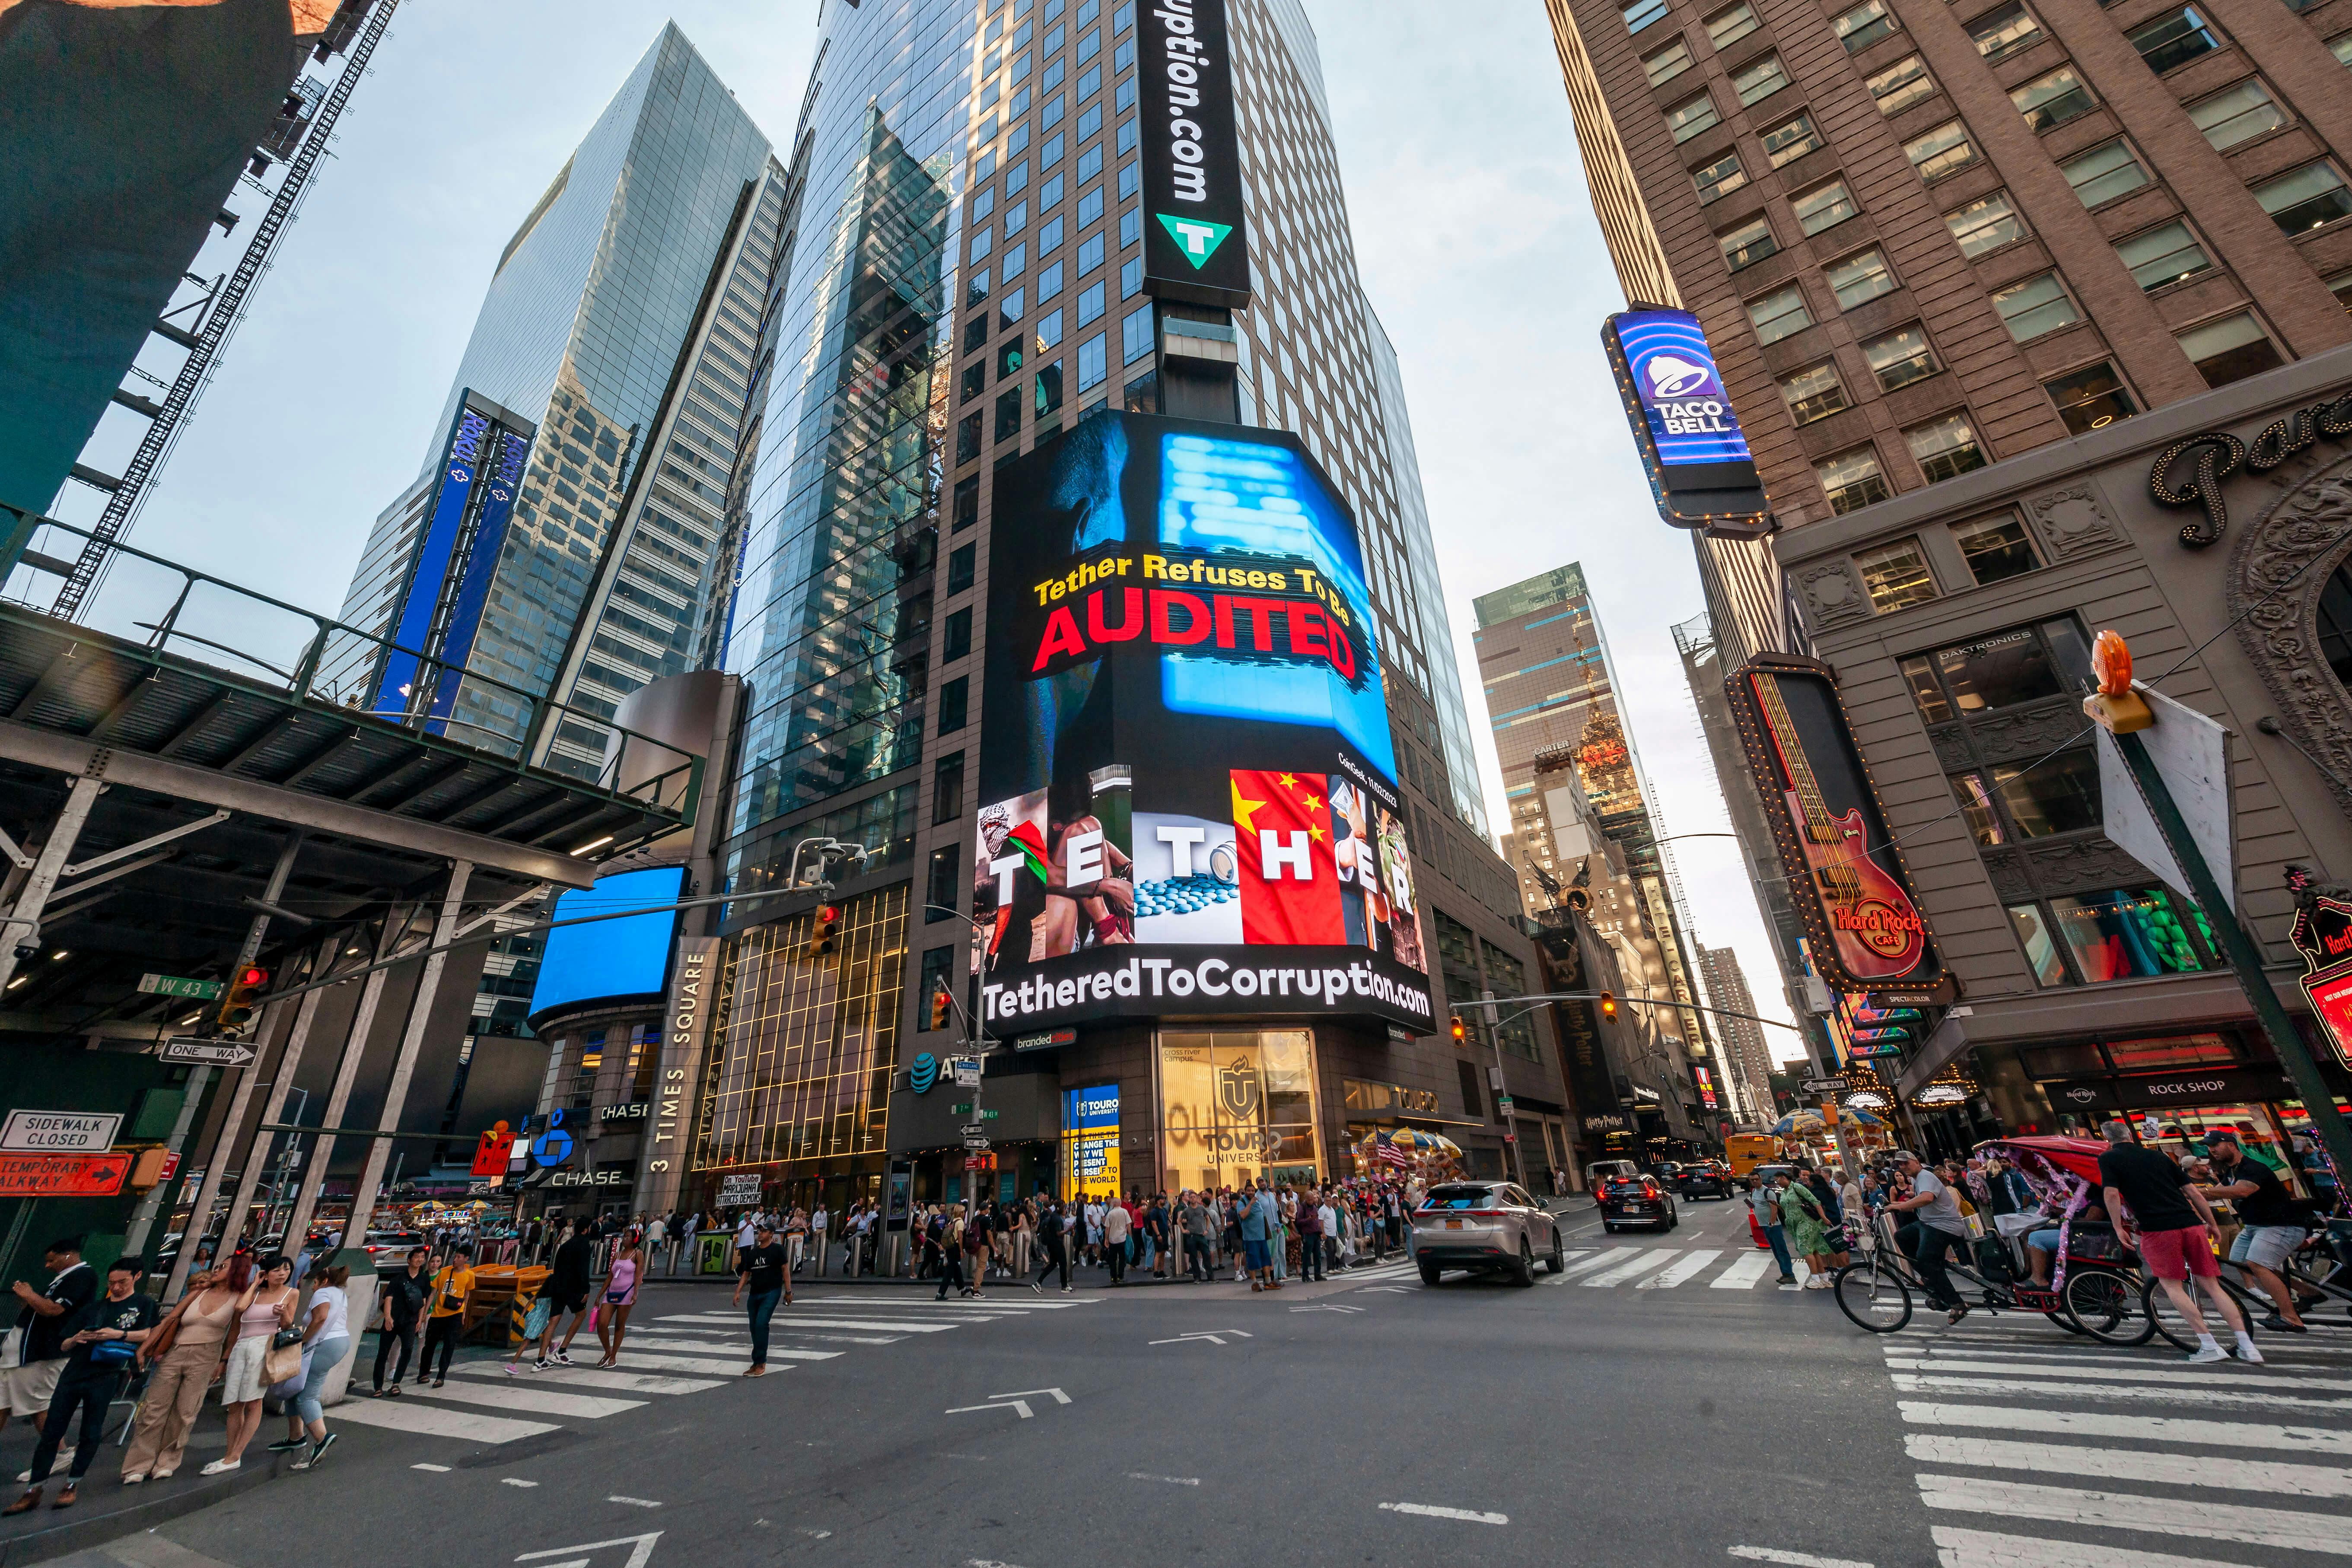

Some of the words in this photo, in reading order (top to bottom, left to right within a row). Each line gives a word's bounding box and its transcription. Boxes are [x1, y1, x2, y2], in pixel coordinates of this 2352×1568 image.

[1654, 401, 1723, 419] TACO
[1665, 417, 1730, 434] BELL
[1034, 557, 1132, 606] Tether
[1143, 554, 1286, 590] Refuses
[1295, 569, 1325, 600] To
[1329, 588, 1349, 627] Be
[1032, 587, 1355, 679] AUDITED
[1939, 631, 2031, 660] DAKTRONICS
[1534, 740, 1569, 755] CARTER
[1339, 753, 1367, 785] CoinGeek,
[1368, 777, 1397, 808] 11/02/2023
[1647, 885, 1674, 952] HOTEL
[1836, 908, 1879, 929] Hard
[1881, 909, 1925, 935] Rock
[1875, 935, 1901, 946] CAFE
[2325, 928, 2350, 955] Hard
[161, 979, 177, 993] W
[182, 982, 201, 996] 43
[984, 957, 1429, 1021] TetheredToCorruption.com
[673, 954, 704, 1044] SQUARE
[2323, 993, 2333, 1002] VISIT
[1017, 1032, 1073, 1049] brandedcities
[173, 1045, 201, 1056] ONE
[216, 1049, 246, 1059] WAY
[939, 1052, 989, 1080] ATT
[2081, 1089, 2097, 1097] Rock
[2148, 1083, 2184, 1095] ROCK
[2188, 1081, 2226, 1092] SHOP
[655, 1069, 684, 1144] TIMES
[1088, 1099, 1119, 1110] TOURO
[25, 1117, 102, 1131] SIDEWALK
[1586, 1116, 1604, 1130] Harry
[1603, 1115, 1623, 1128] Potter
[27, 1133, 88, 1145] CLOSED
[1074, 1141, 1103, 1150] CANGE
[1104, 1139, 1119, 1147] THE
[1203, 1131, 1283, 1151] TOURO
[2, 1161, 92, 1174] TEMPORARY
[650, 1159, 668, 1172] 3
[1074, 1158, 1106, 1168] PESENT
[552, 1171, 622, 1186] CHASE
[1074, 1167, 1106, 1177] ORSELF
[722, 1183, 756, 1194] MARIJUANA
[716, 1194, 738, 1206] ATTRACTS
[739, 1193, 761, 1203] DEMONS
